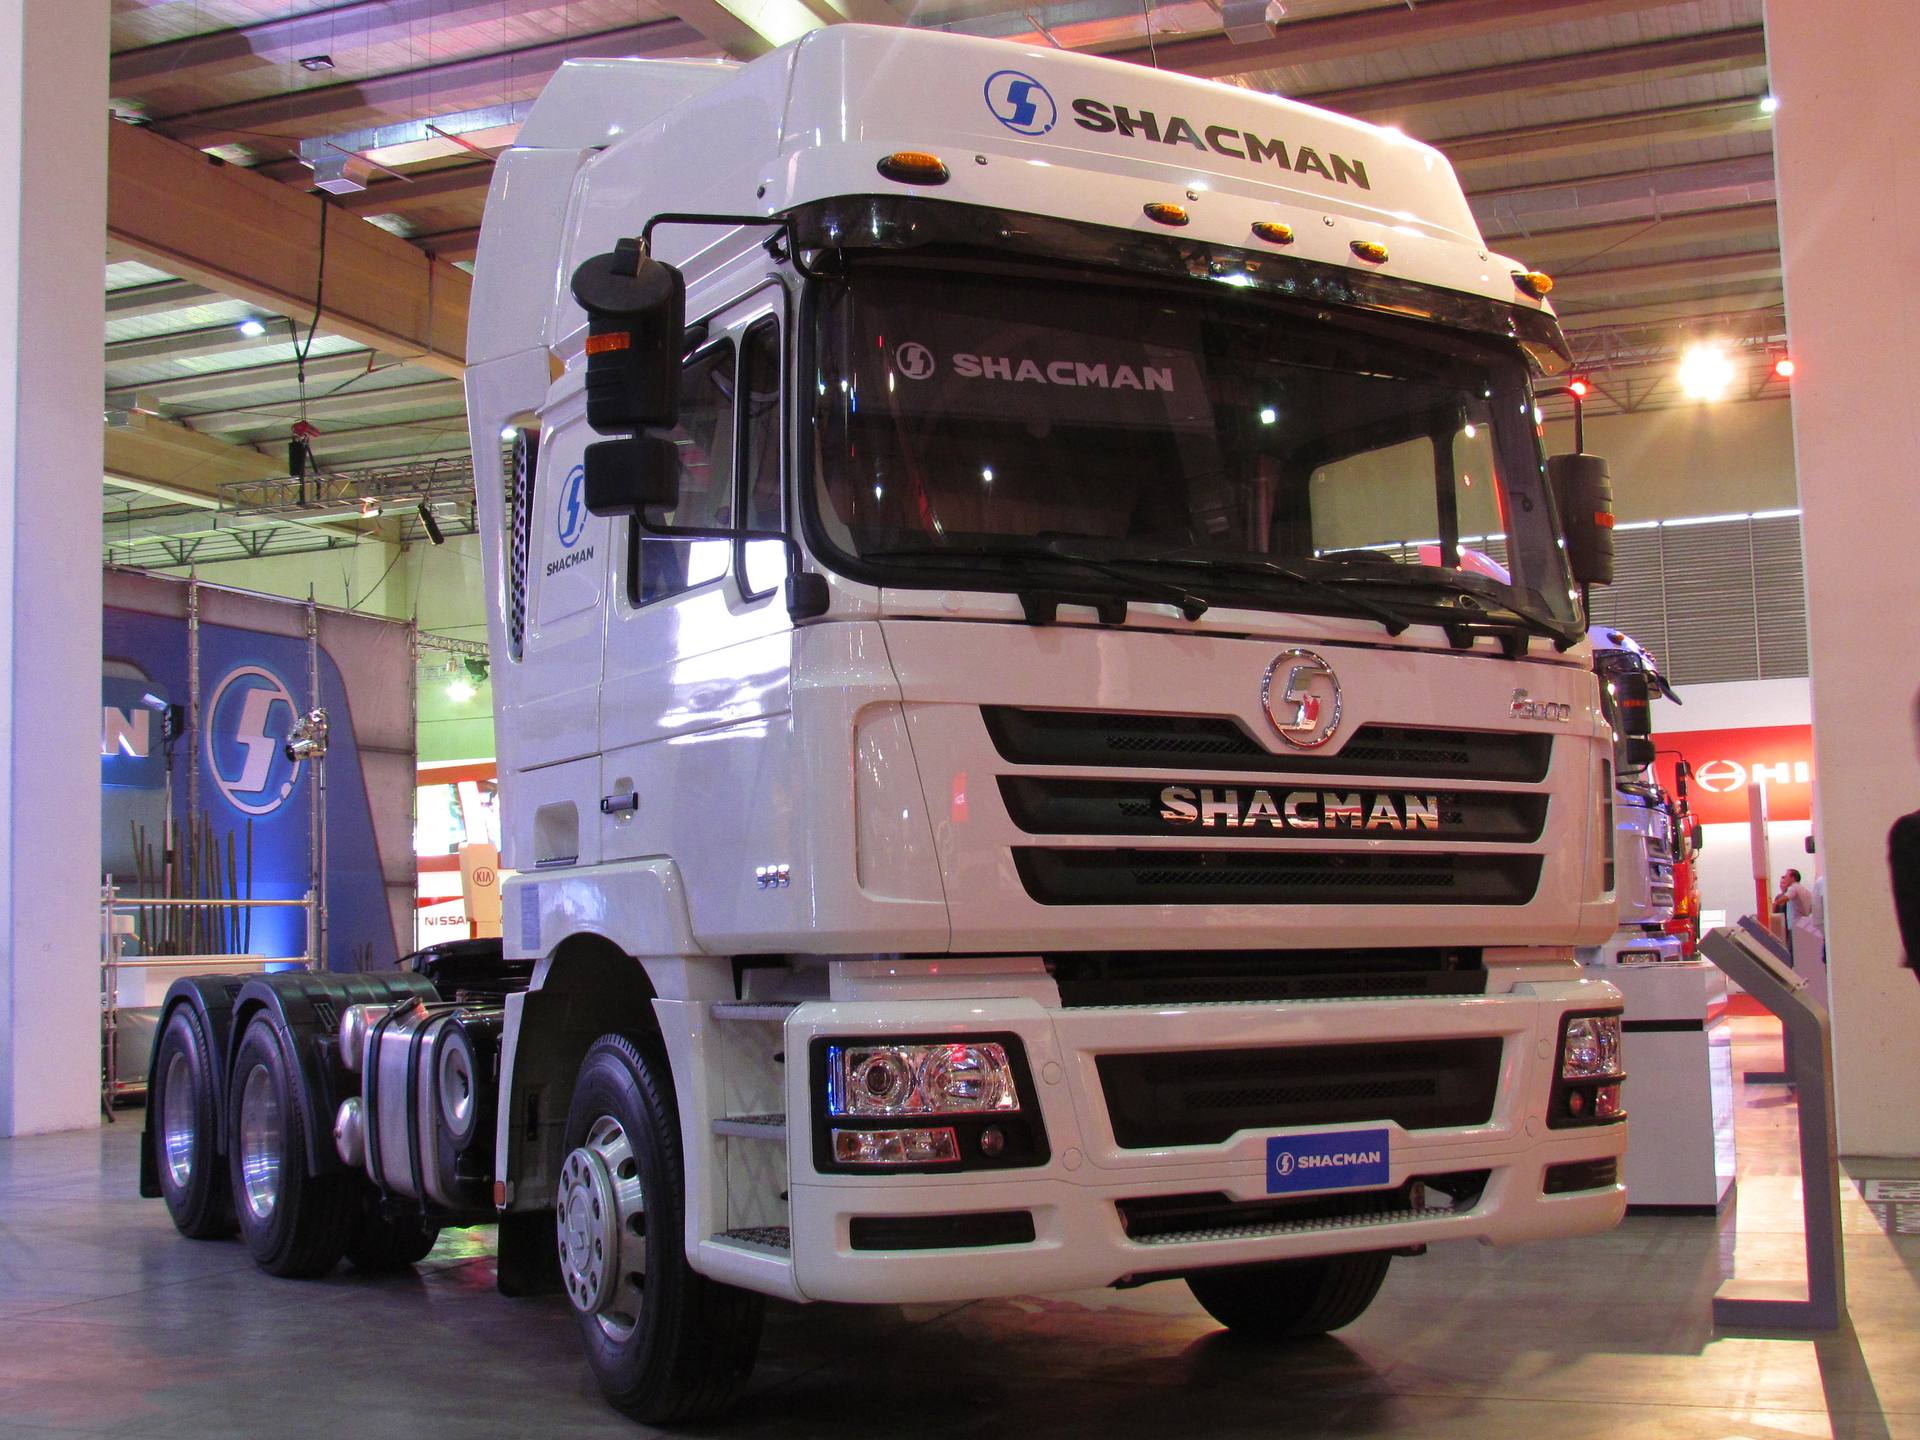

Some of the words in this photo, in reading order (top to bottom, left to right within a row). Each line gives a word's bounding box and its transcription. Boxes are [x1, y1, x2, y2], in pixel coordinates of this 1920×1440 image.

[1072, 99, 1370, 190] SHACMAN
[953, 353, 1174, 391] SHACMAN
[546, 546, 594, 577] SHACMAN
[103, 706, 149, 757] N
[1160, 786, 1439, 829] SHACMAN
[476, 871, 491, 882] KIA
[424, 915, 467, 926] NISSA
[1298, 1151, 1380, 1168] SHACMAN
